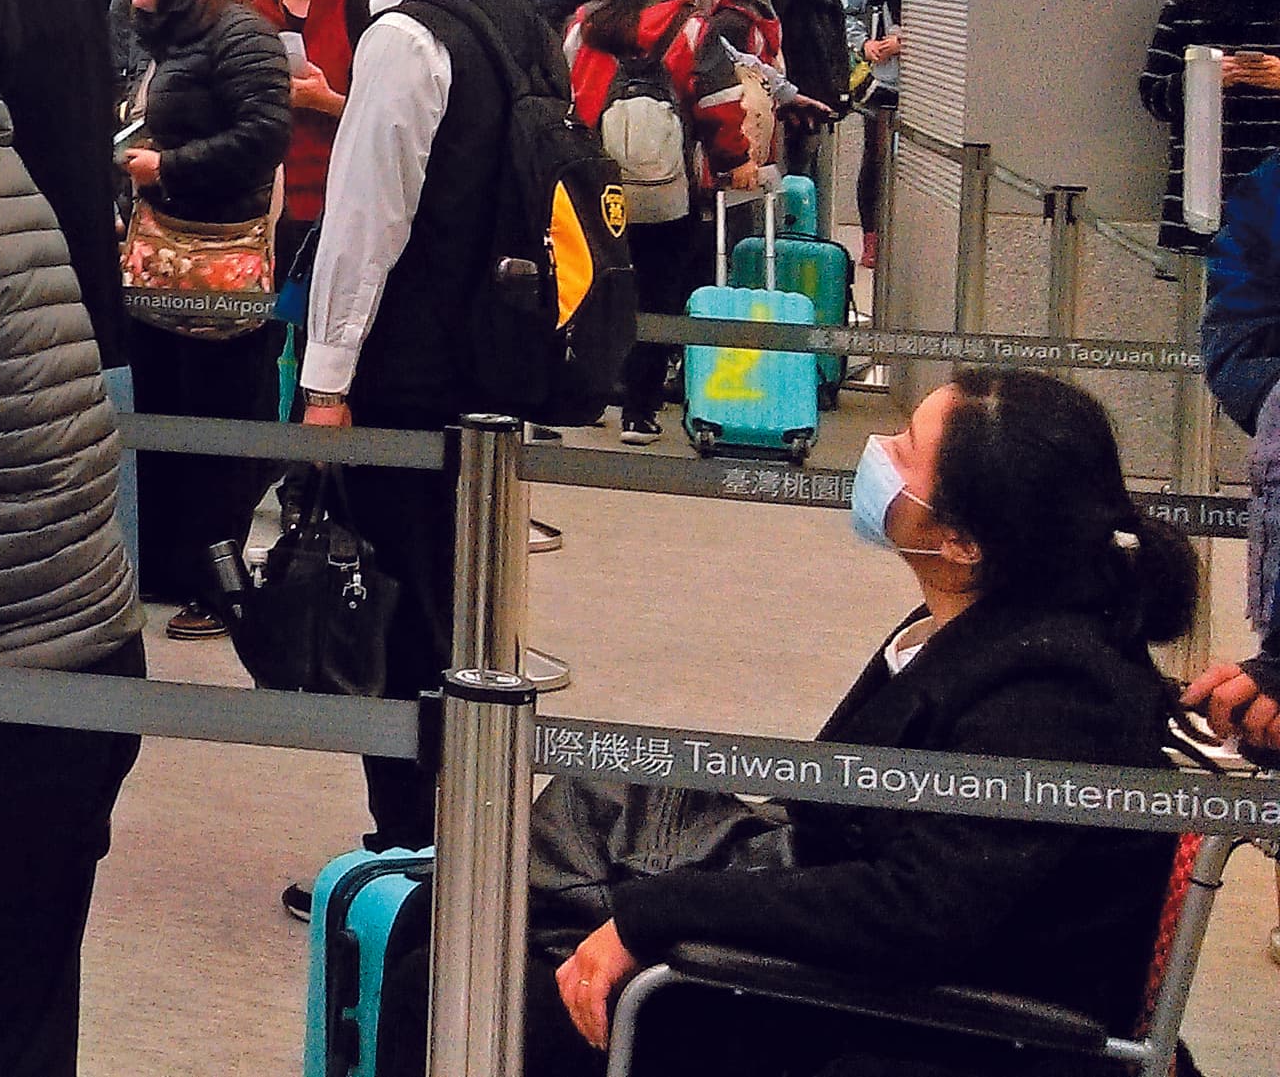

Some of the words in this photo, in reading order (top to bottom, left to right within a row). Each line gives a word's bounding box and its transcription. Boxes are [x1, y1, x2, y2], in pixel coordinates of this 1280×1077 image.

[992, 338, 1060, 360] Taiwan
[1067, 343, 1154, 367] Taoyuan
[534, 725, 675, 778] 際機場
[684, 739, 822, 784] Taiwan
[834, 754, 1007, 803] Taoyuan
[1024, 770, 1280, 825] Internationa
